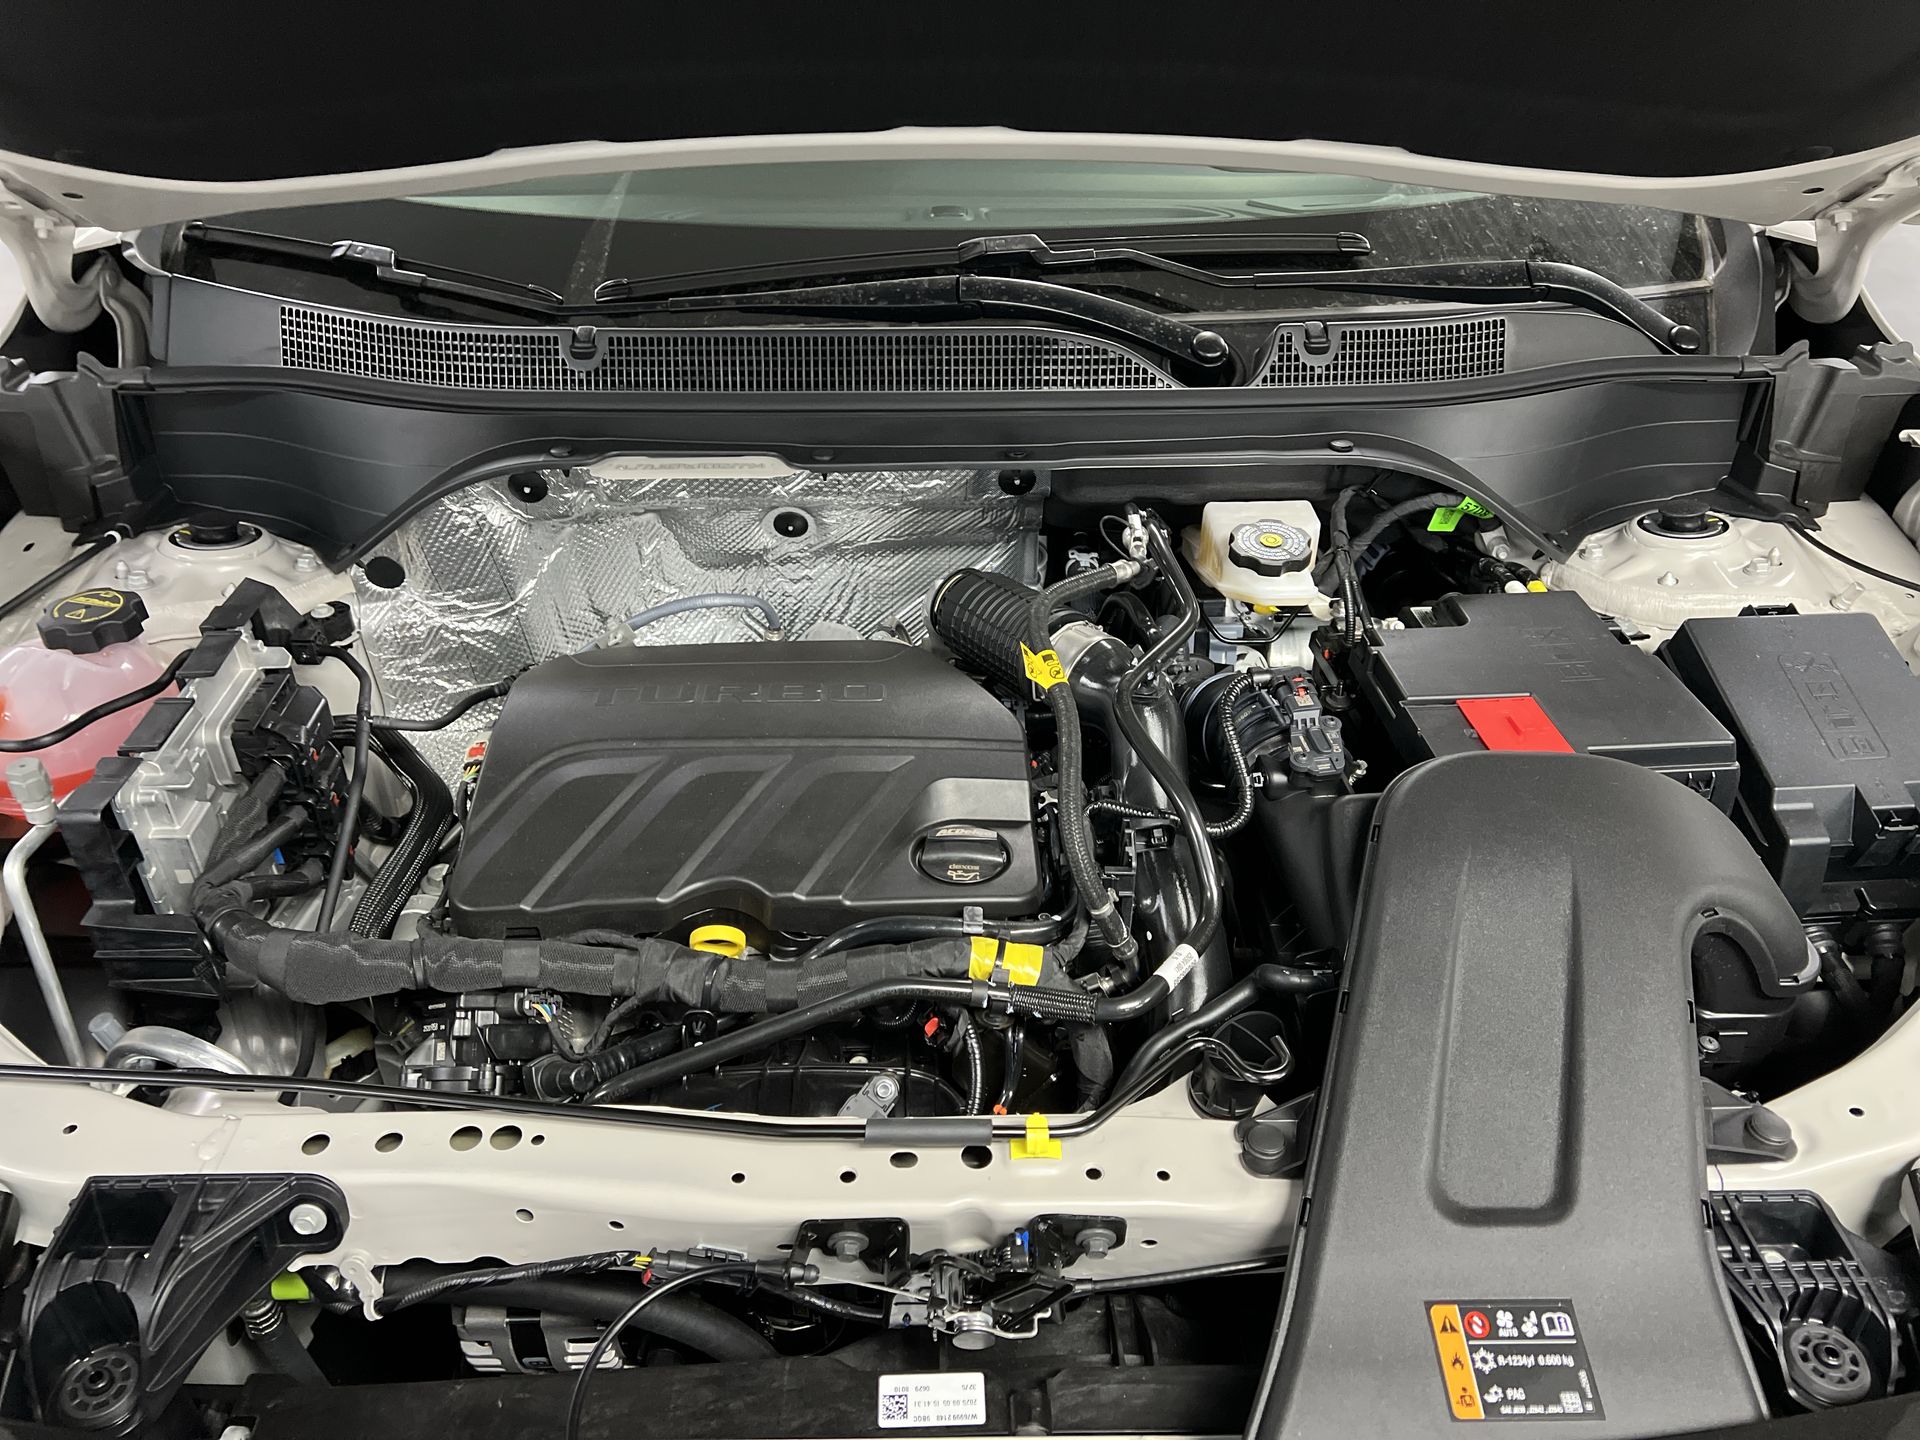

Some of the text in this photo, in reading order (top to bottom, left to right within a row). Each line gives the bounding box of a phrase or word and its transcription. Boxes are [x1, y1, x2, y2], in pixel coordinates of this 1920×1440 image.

[580, 682, 887, 706] TURBO
[1498, 1327, 1519, 1338] AUTO
[1496, 1354, 1536, 1368] R-1234yf
[1562, 1353, 1575, 1368] kg
[1505, 1387, 1526, 1401] PAG
